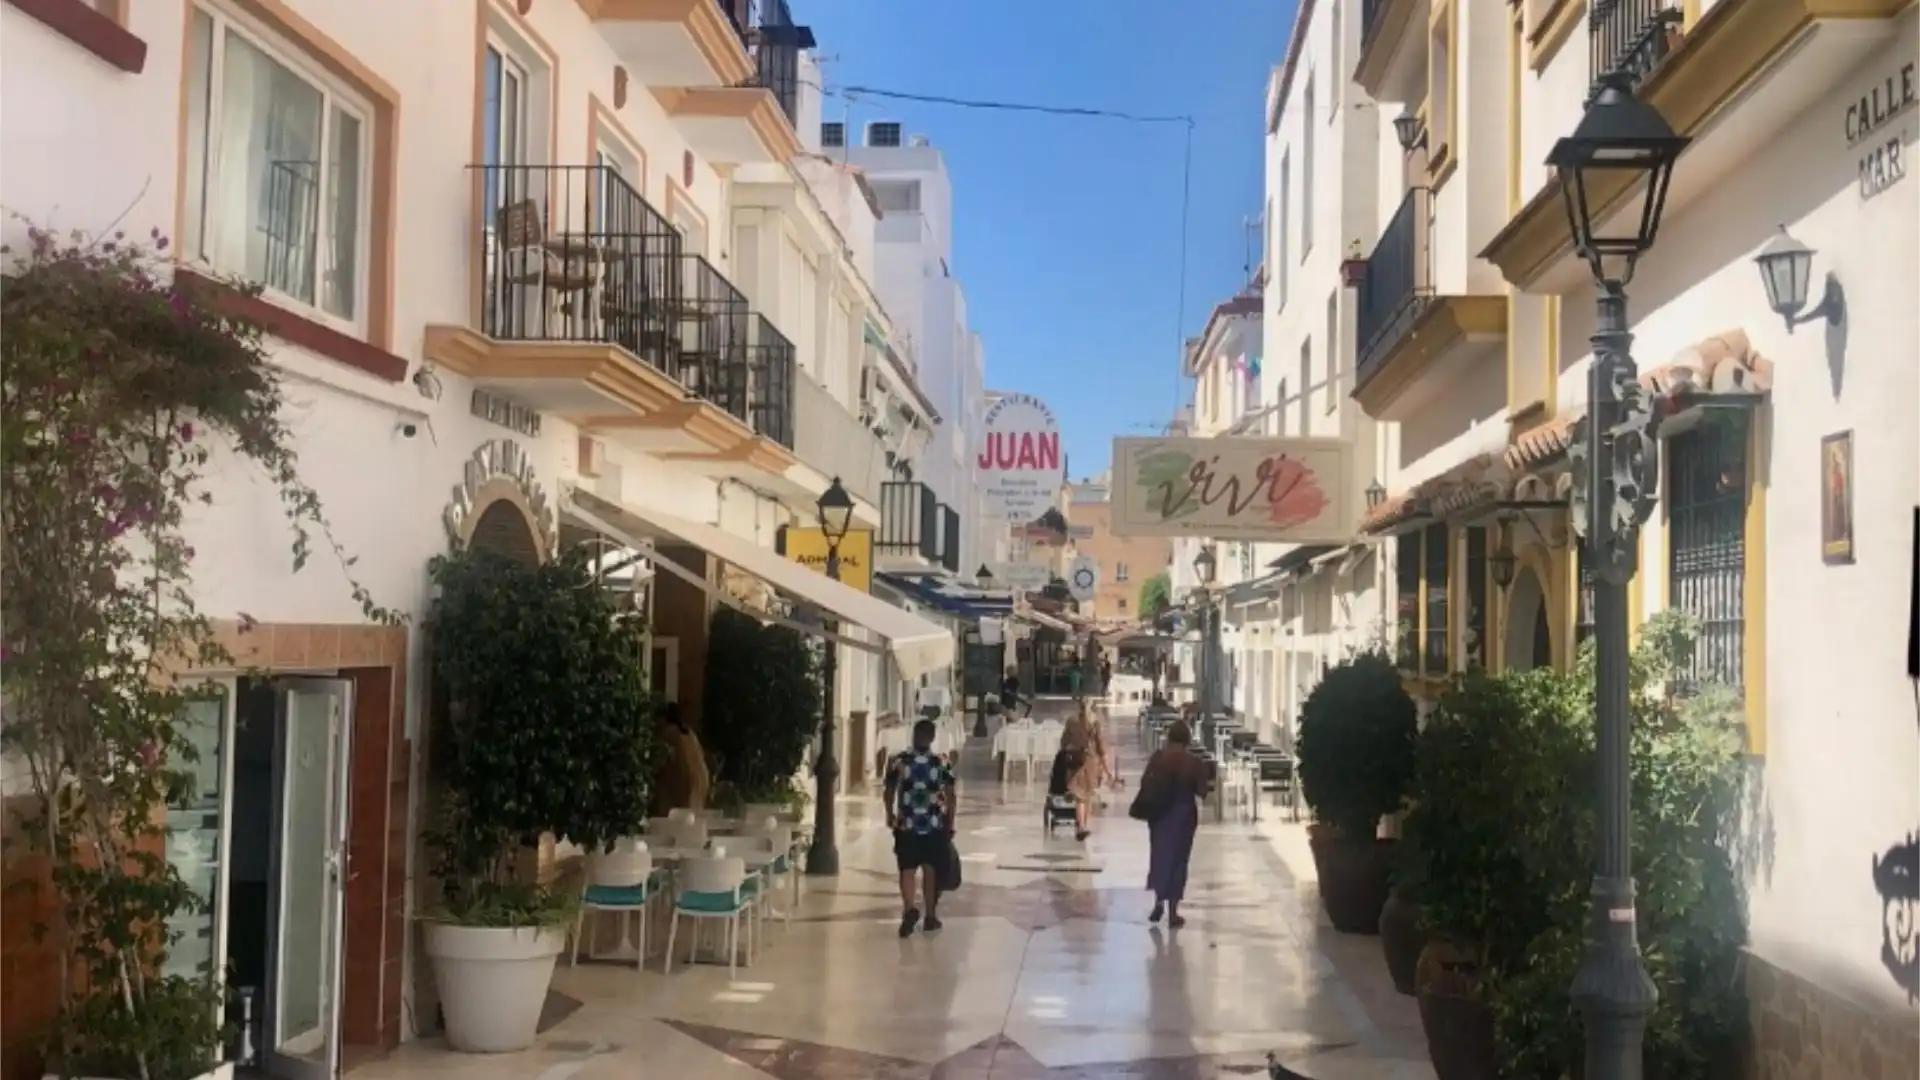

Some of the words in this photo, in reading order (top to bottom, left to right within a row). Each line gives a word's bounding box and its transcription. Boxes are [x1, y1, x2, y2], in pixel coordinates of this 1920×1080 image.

[1846, 62, 1914, 140] CALLE
[1859, 138, 1902, 198] MAR
[978, 431, 1060, 470] JUAN
